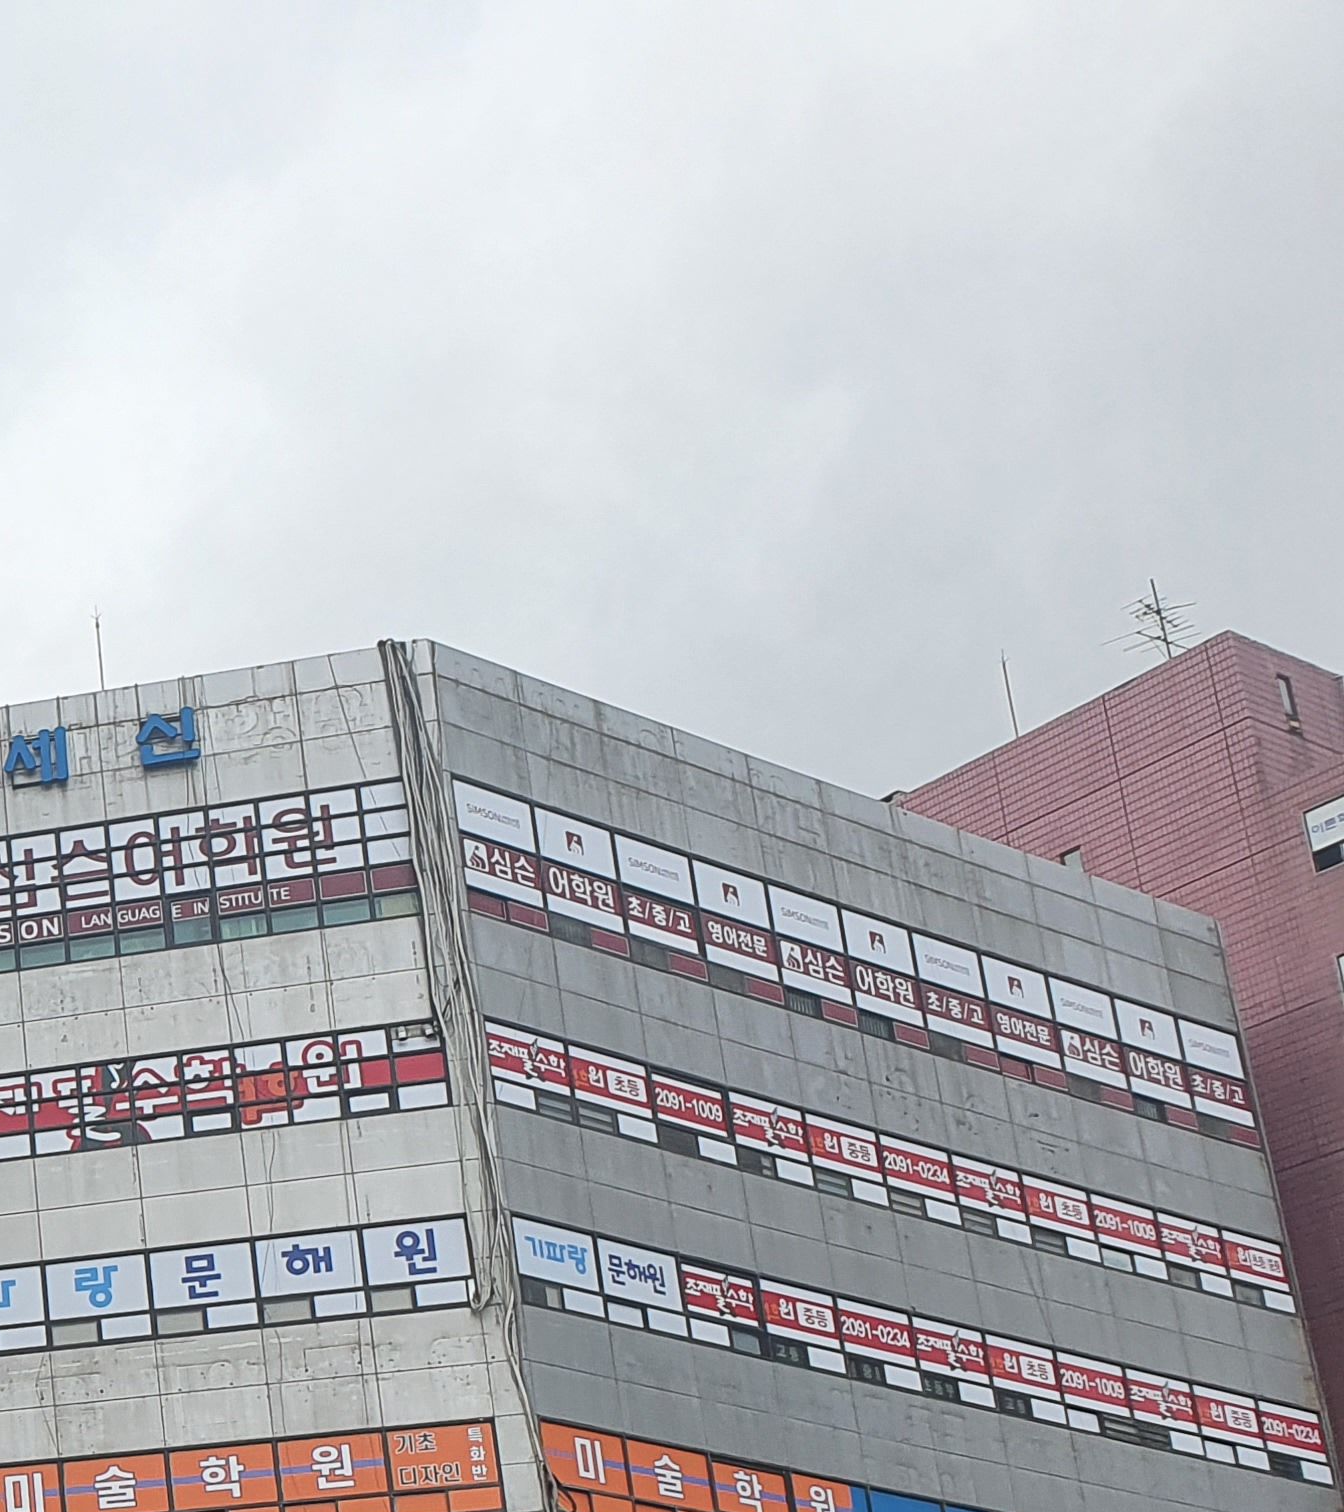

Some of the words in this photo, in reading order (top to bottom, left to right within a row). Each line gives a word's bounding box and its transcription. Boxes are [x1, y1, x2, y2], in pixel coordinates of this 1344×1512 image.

[80, 903, 184, 930] LANGUAGE
[490, 848, 539, 889] 심슨
[549, 867, 615, 914] 어학원
[627, 895, 693, 935] 초/중/고
[707, 920, 769, 957] 영어전문
[803, 949, 845, 988] 심슨
[854, 963, 916, 1009] 어학원
[926, 989, 985, 1026] 초/중/고
[996, 1012, 1052, 1048] 영어전문
[1083, 1038, 1122, 1073] 심슨
[1128, 1051, 1185, 1093] 어학원
[655, 1087, 724, 1123] 2091-1009
[882, 1151, 951, 1187] 2091-0234
[1093, 1208, 1157, 1242] 2091-1009
[524, 1234, 589, 1277] 기파랑
[607, 1253, 667, 1298] 문해원
[840, 1313, 911, 1349] 2091-0234
[1059, 1368, 1126, 1401] 2091-1009
[395, 1430, 437, 1455] 기초
[1262, 1415, 1322, 1447] 2091-0234
[398, 1462, 462, 1486] 디자인
